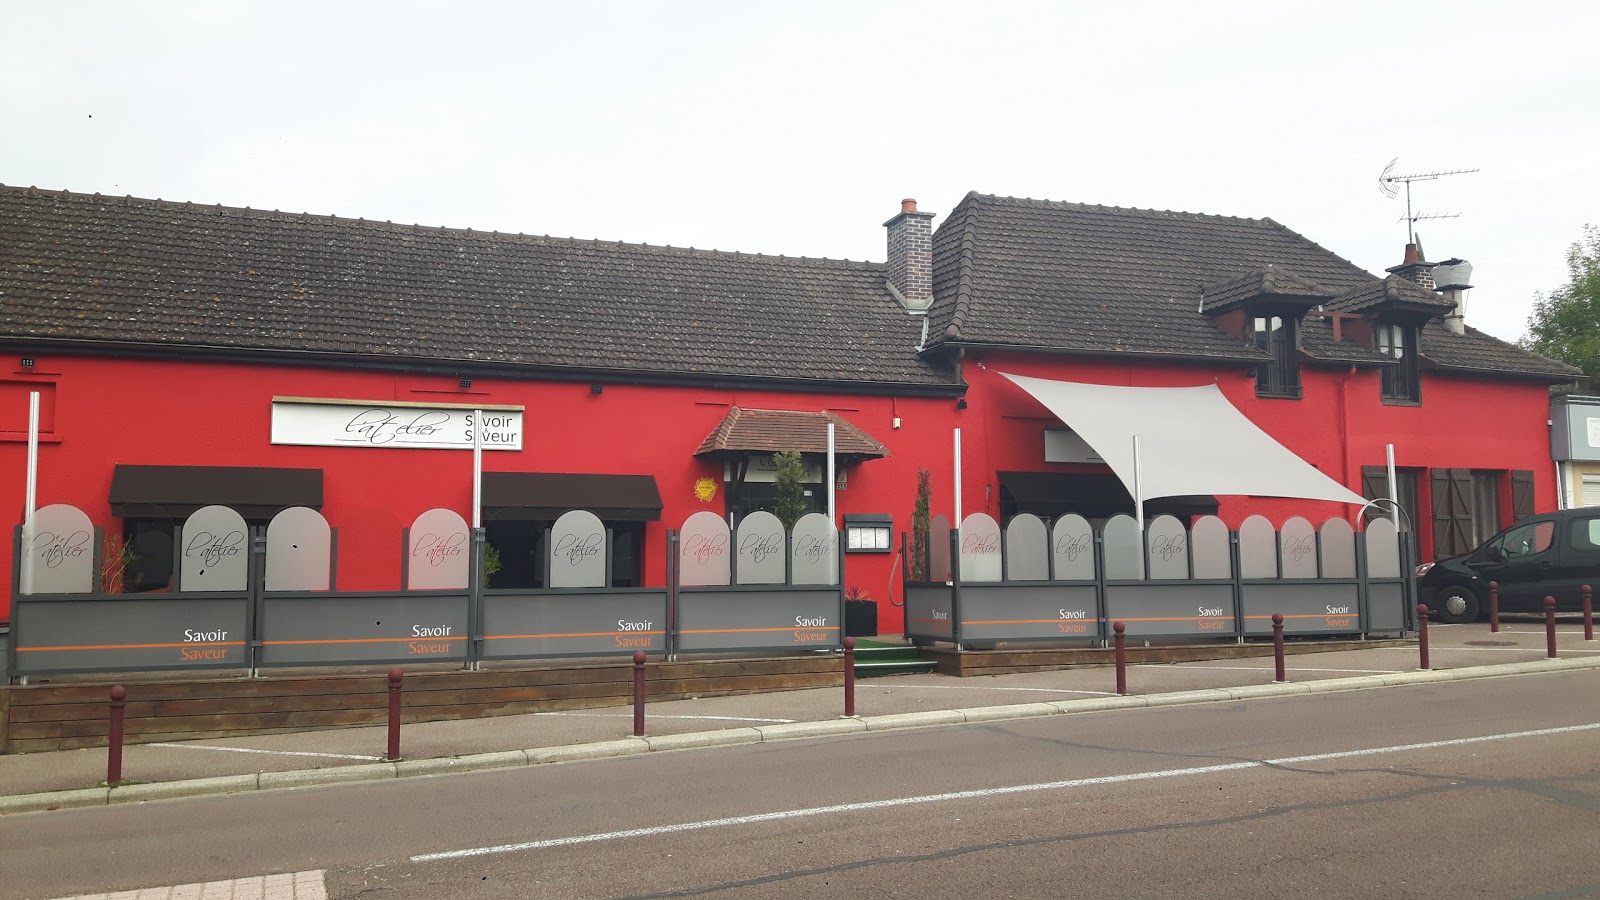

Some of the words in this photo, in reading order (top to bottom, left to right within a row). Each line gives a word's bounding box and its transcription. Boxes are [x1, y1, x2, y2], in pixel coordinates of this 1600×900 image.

[465, 414, 513, 428] Svoir
[465, 429, 517, 444] Sveur
[1059, 609, 1086, 619] Savoir
[1198, 606, 1223, 616] Savoir
[1326, 604, 1349, 614] Savoir
[617, 619, 652, 631] Savoir
[795, 616, 826, 627] Savoir
[1198, 619, 1225, 630] Saveur
[1326, 617, 1350, 627] Saveur
[412, 624, 451, 637] Savoir
[1058, 622, 1086, 633] Saveur
[184, 629, 227, 642] Savoir
[615, 635, 652, 647] Saveur
[794, 631, 827, 642] Saveur
[409, 641, 451, 654] Saveur
[181, 647, 227, 661] Saveur
